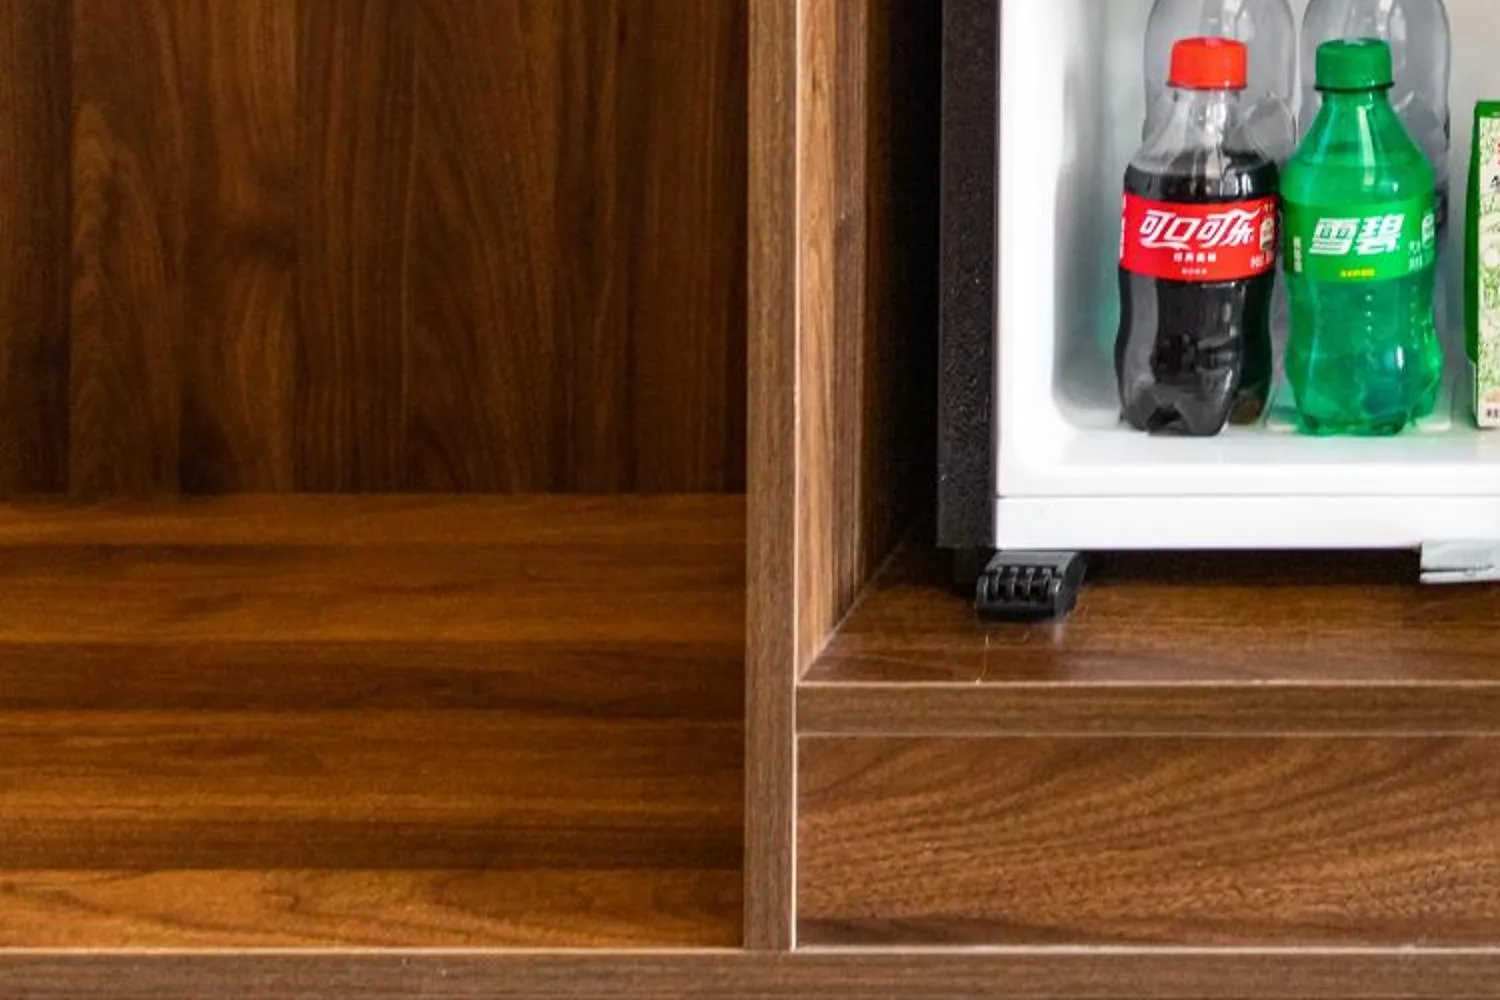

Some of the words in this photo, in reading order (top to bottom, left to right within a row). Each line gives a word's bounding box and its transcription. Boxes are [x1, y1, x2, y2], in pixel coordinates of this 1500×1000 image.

[1139, 208, 1261, 250] 可口可乐
[1308, 213, 1405, 256] 雪碧
